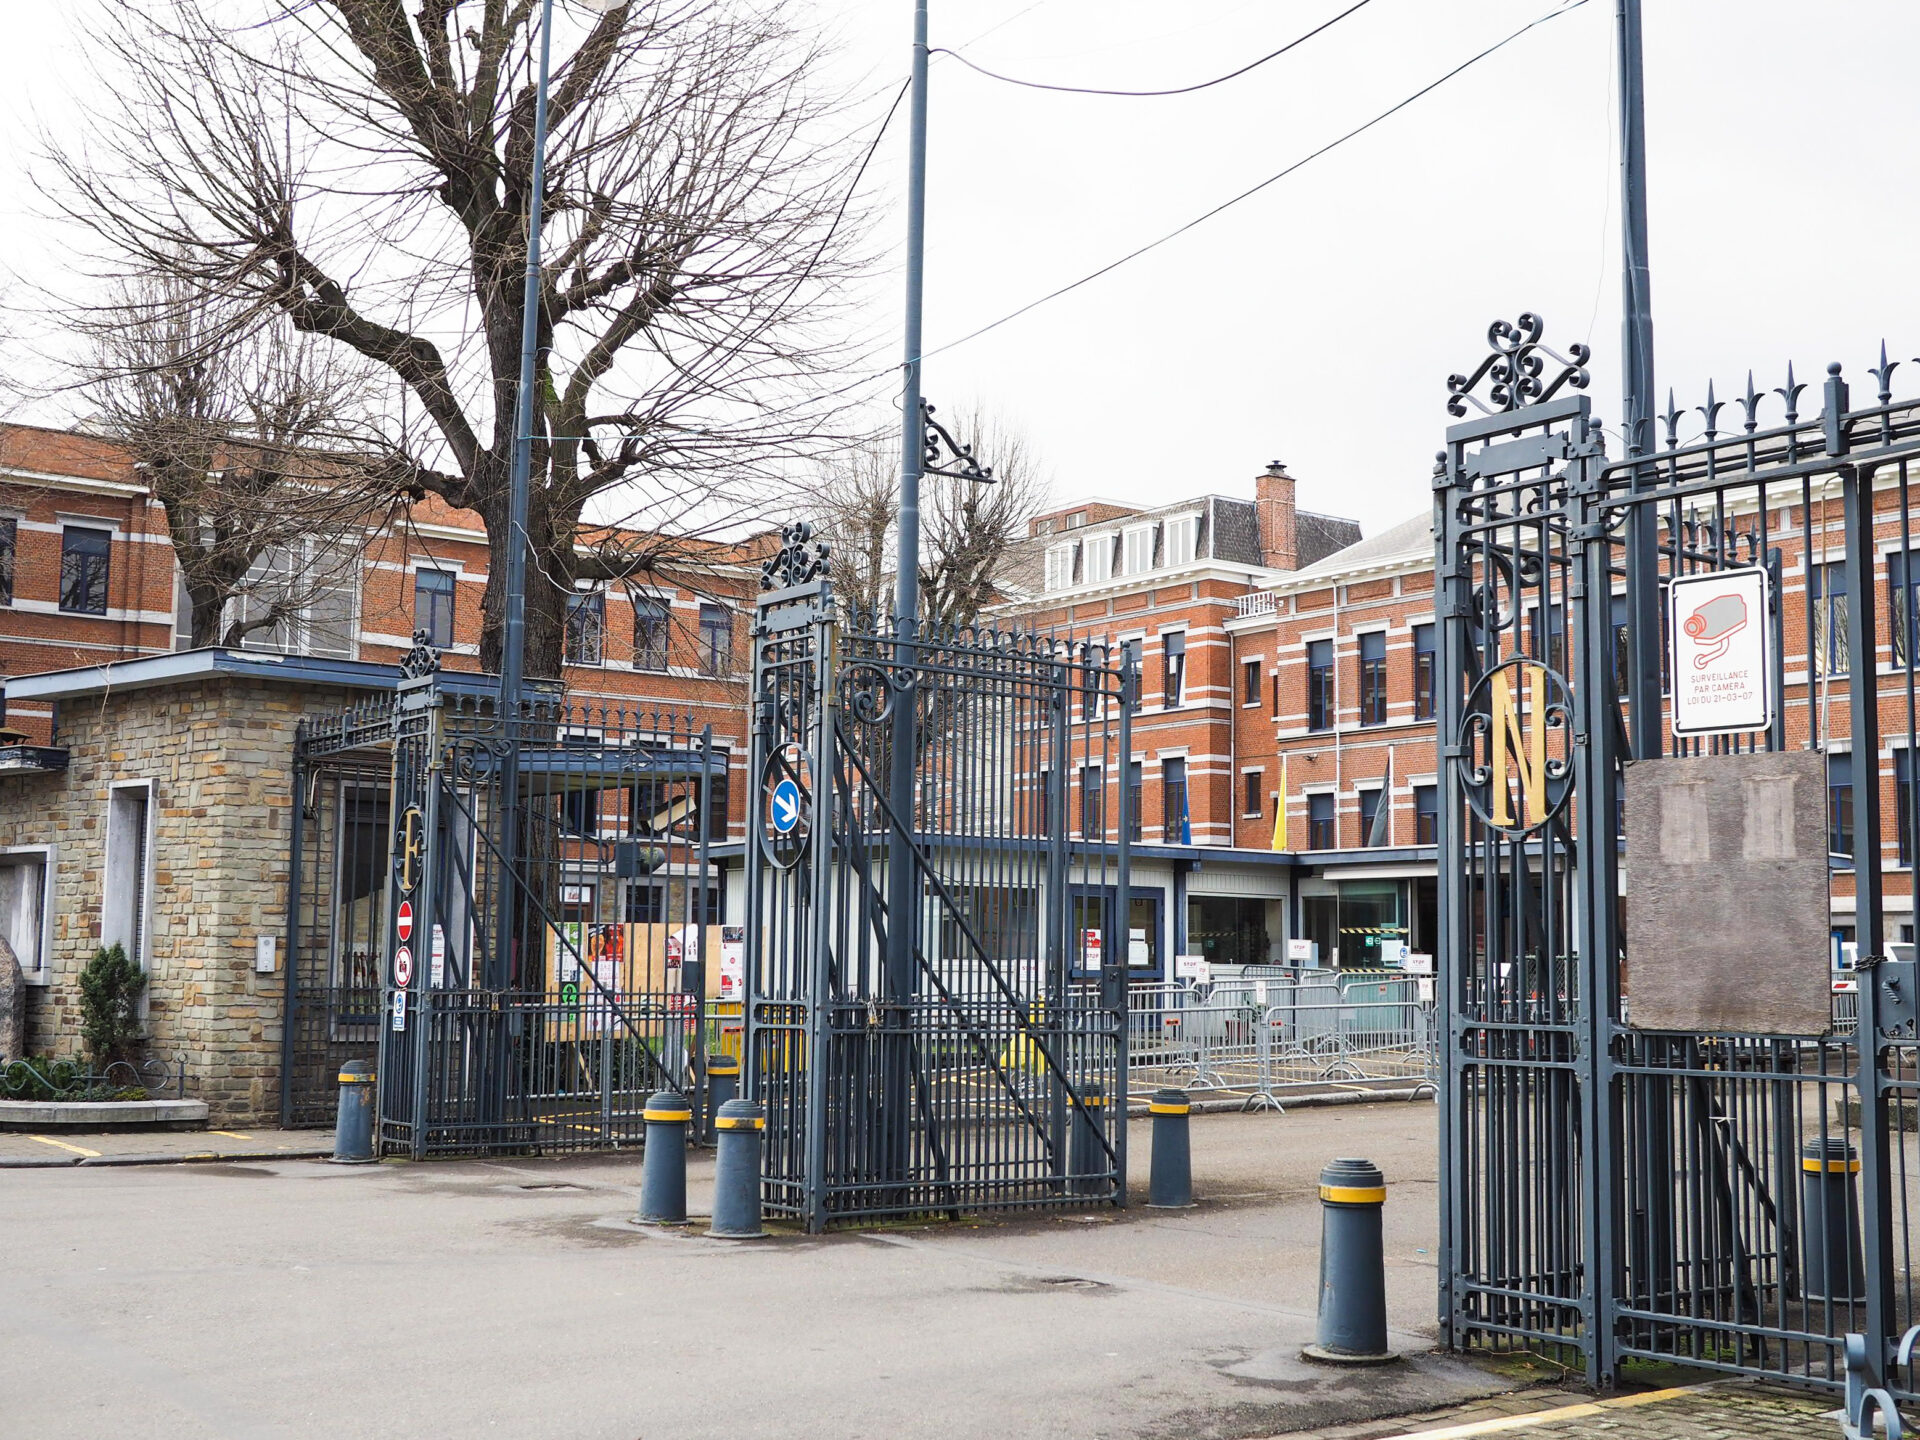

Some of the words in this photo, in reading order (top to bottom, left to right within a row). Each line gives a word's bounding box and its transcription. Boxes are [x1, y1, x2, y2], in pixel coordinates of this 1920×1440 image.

[1690, 669, 1749, 684] SURVEILLANCE
[1694, 684, 1710, 694] PAR
[1711, 681, 1746, 692] CAMERA
[1687, 696, 1700, 705] LOI
[1700, 695, 1712, 704] DU
[1713, 691, 1753, 703] 21-03-07
[1489, 665, 1548, 826] N
[402, 809, 422, 890] F
